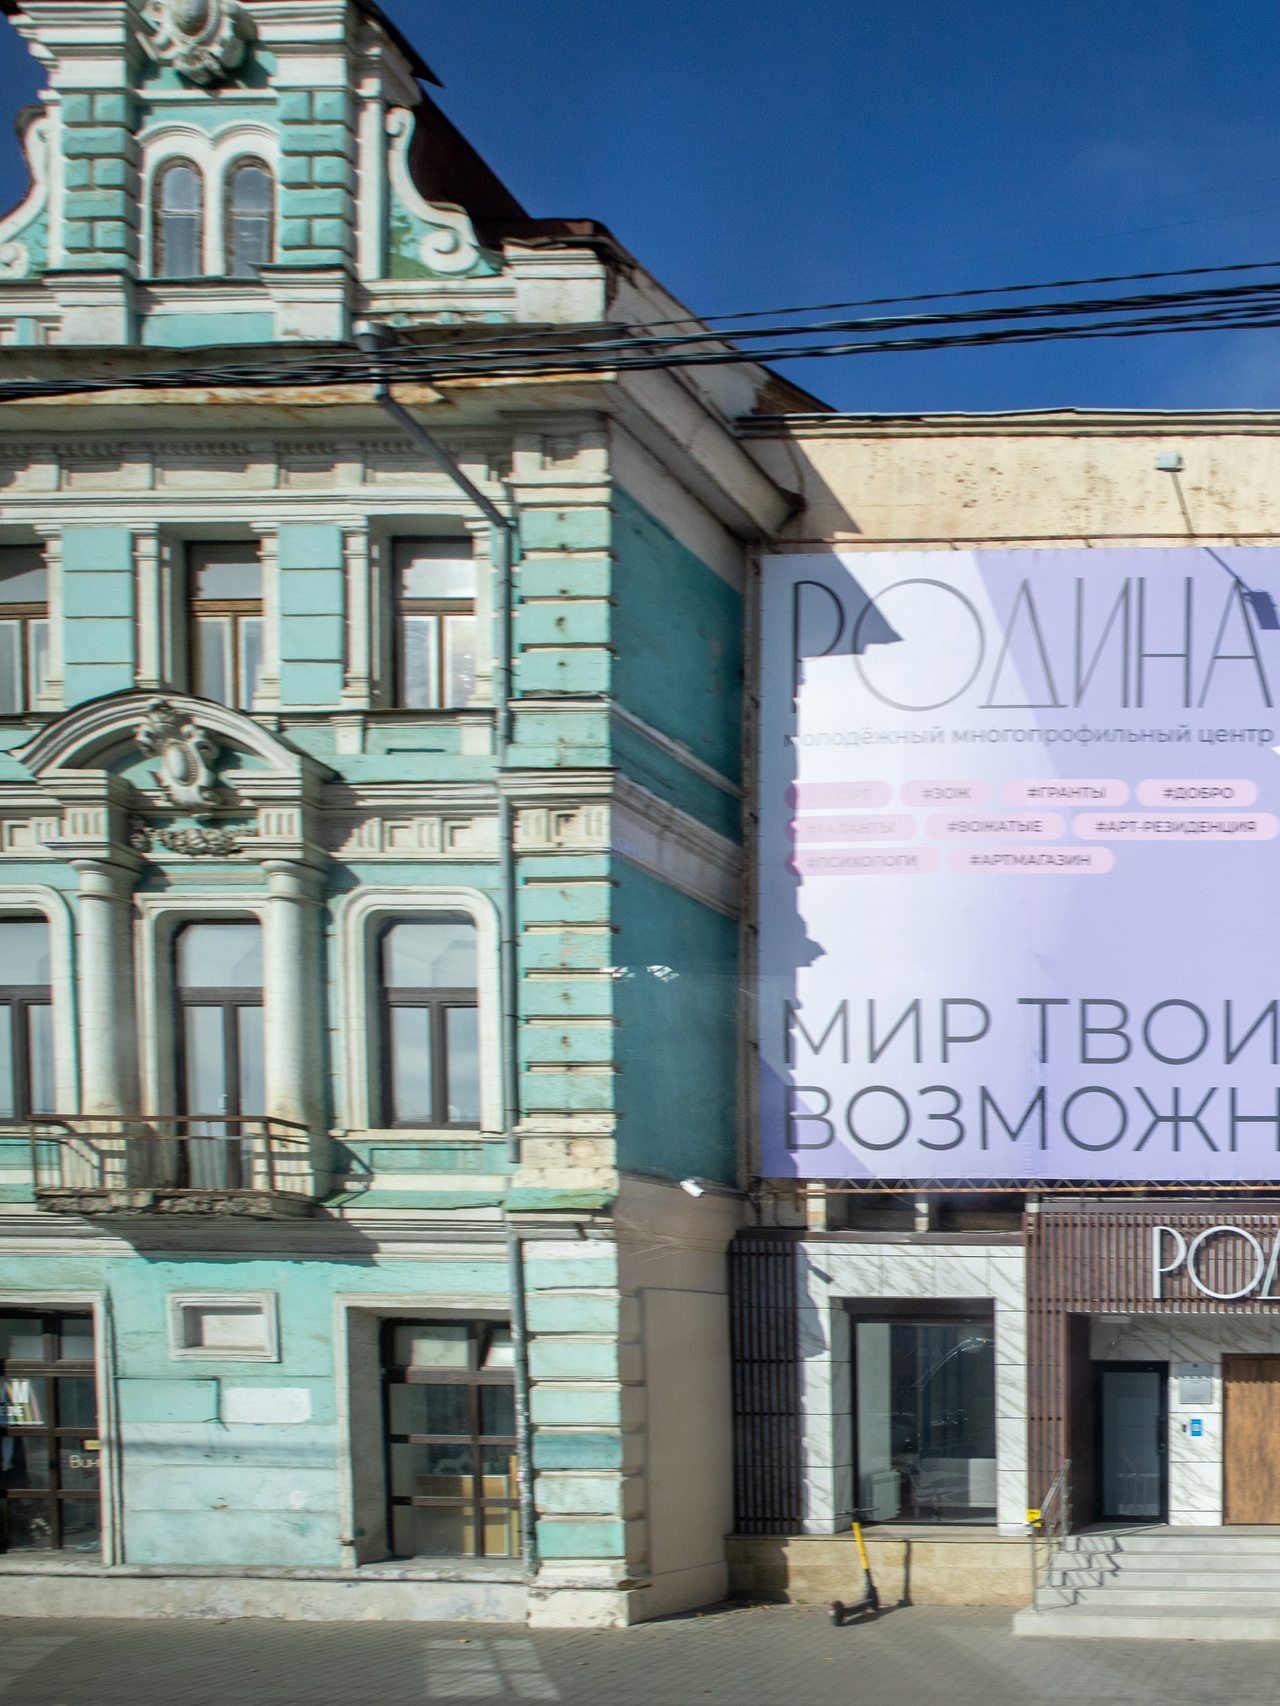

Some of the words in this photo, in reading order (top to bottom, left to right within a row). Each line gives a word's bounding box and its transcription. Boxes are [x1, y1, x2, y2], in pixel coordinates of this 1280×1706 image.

[790, 576, 1274, 712] РОДИНА
[951, 724, 1191, 747] многопрофильный
[1198, 728, 1276, 747] центр
[921, 787, 972, 800] #ЗОЖ
[1026, 786, 1107, 799] #ГРАНТЫ
[1162, 786, 1236, 801] #ДОБРО
[946, 820, 1044, 833] #ВОЖАТЫЕ
[1095, 820, 1258, 835] #АРТ-РЕЗИДЕНЦИЯ
[968, 853, 1092, 867] #АРТМАГАЗИН
[783, 997, 991, 1066] МИР
